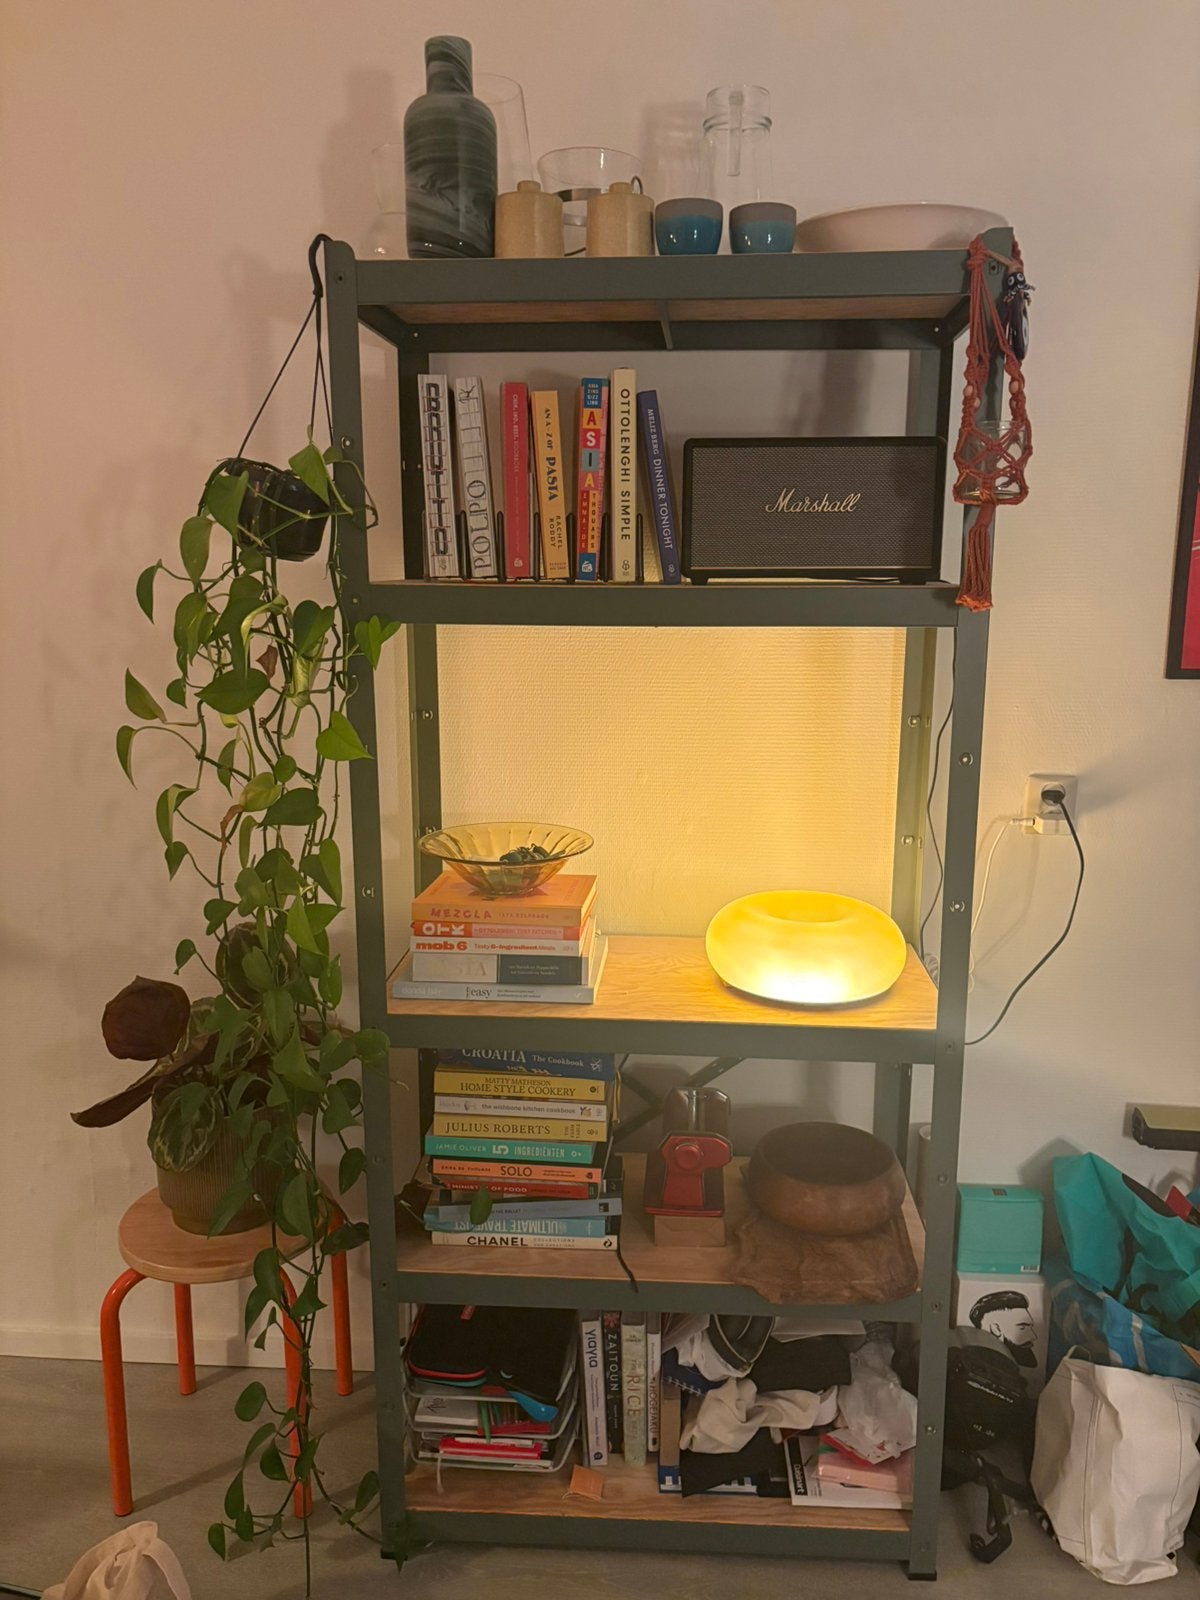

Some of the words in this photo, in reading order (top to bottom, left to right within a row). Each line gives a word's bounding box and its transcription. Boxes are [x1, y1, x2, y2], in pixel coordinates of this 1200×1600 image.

[648, 408, 657, 434] MELIZ
[620, 388, 631, 483] OTTOLENGHI
[650, 434, 660, 455] BERG
[583, 413, 598, 488] ASIA
[425, 382, 449, 556] BRUTTO
[546, 456, 559, 501] PASTA
[653, 458, 666, 500] DINNER
[765, 487, 861, 513] Marshall
[466, 479, 491, 570] POLPO
[621, 490, 631, 541] SIMPLE
[659, 502, 673, 550] TONIGHT
[555, 515, 563, 549] RACHEL
[430, 908, 492, 920] MEZCLA
[422, 922, 465, 936] OTK
[415, 941, 454, 950] mob
[456, 941, 468, 951] 6
[470, 988, 492, 999] easy
[462, 1048, 526, 1063] CROATIA
[532, 1054, 546, 1063] The
[547, 1056, 584, 1067] Cookbook
[460, 1082, 492, 1092] HOME
[494, 1084, 526, 1094] STYLE
[528, 1086, 576, 1097] COOKERY
[484, 1077, 510, 1085] MATTY
[511, 1078, 551, 1086] MATHESON
[446, 1122, 489, 1133] JULIUS
[493, 1124, 551, 1135] ROBERTS
[435, 1143, 457, 1151] JAMIE
[459, 1144, 487, 1152] OLIVER
[492, 1144, 509, 1155] 5
[514, 1145, 565, 1158] INGREDIËNTEN
[500, 1165, 532, 1177] SOLO
[510, 1220, 559, 1233] ULTIMATE
[467, 1236, 528, 1247] CHANEL
[608, 1333, 618, 1392] ZAITOUN
[626, 1375, 641, 1417] RICE
